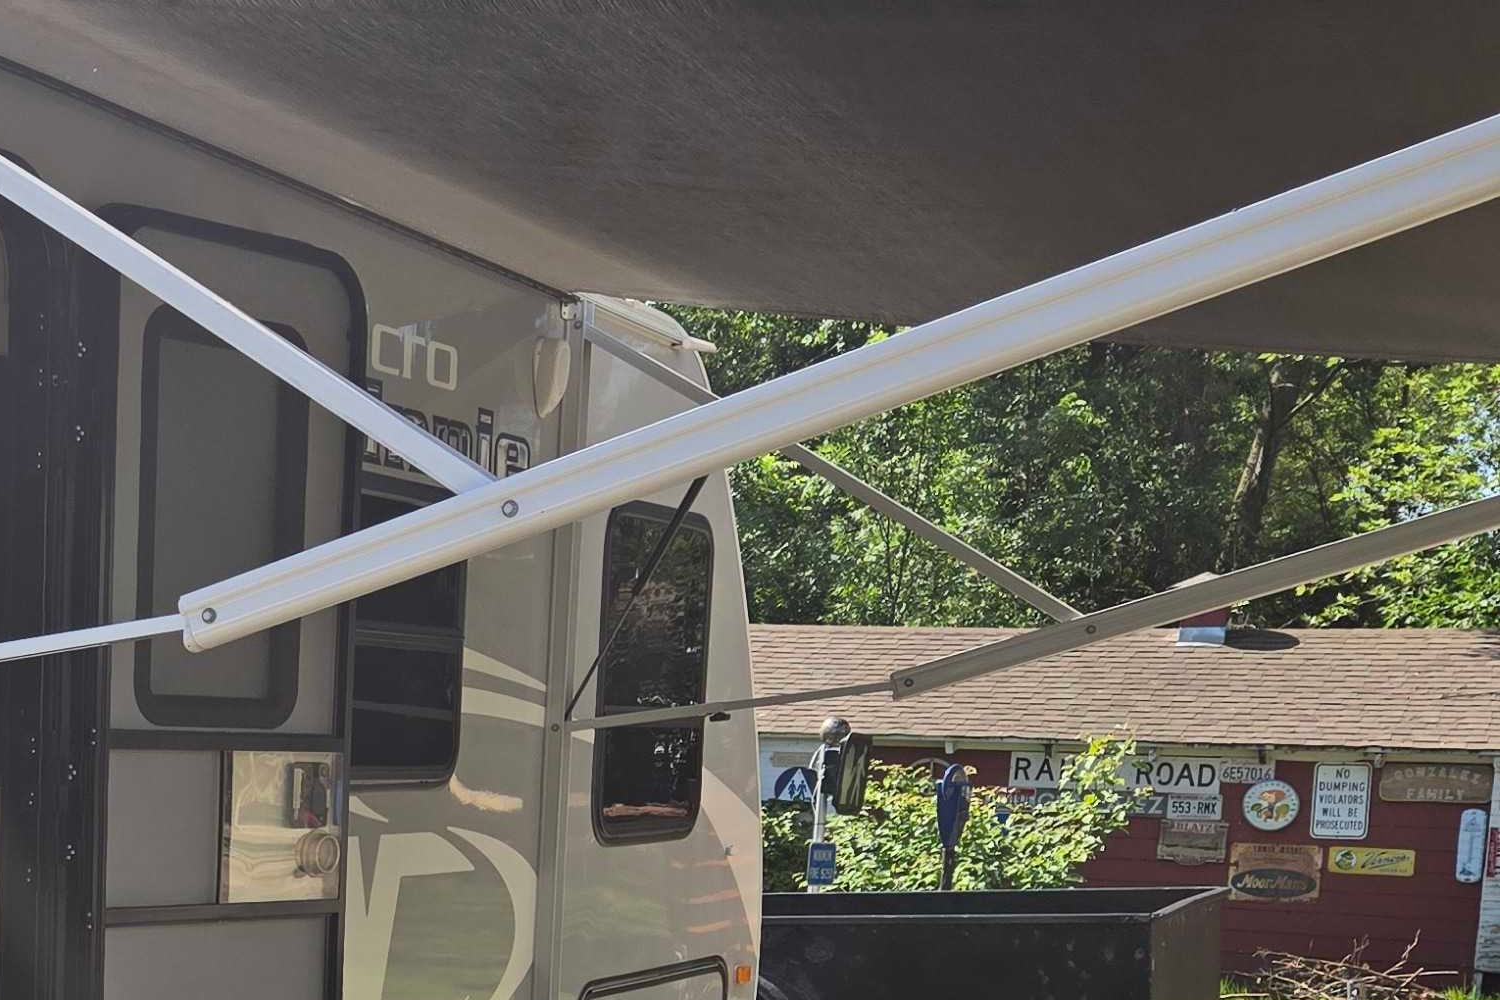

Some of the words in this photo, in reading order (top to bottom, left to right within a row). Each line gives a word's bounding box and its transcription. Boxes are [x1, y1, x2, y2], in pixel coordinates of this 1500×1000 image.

[371, 323, 458, 391] cro
[1135, 762, 1216, 787] ROAD
[1335, 768, 1350, 779] NO
[1319, 781, 1365, 792] DUMPING
[1319, 794, 1364, 805] VIOLATORS
[1322, 807, 1340, 818] WILL
[1348, 807, 1359, 818] BE
[1315, 819, 1363, 830] PROSECUTED
